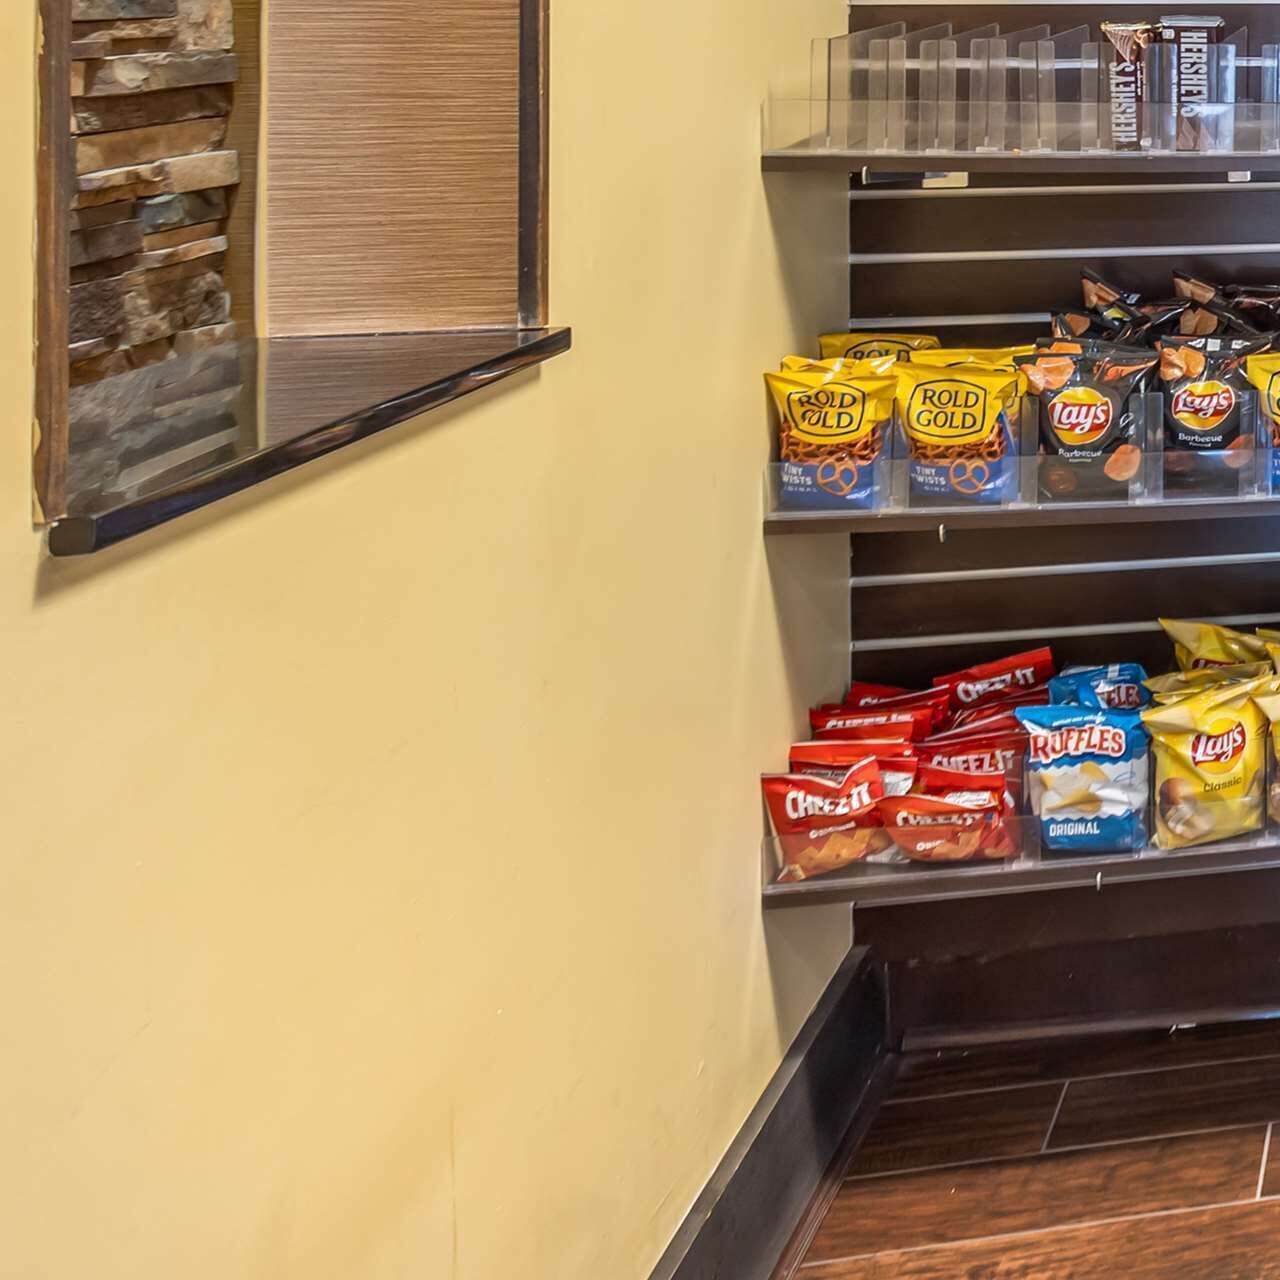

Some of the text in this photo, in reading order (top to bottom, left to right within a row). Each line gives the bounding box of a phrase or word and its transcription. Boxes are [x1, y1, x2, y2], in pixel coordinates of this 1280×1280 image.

[1180, 29, 1208, 118] HERSHEY'S
[1109, 62, 1137, 142] HERSHEY'S
[797, 390, 857, 409] ROLD
[922, 388, 980, 409] ROLD
[1176, 388, 1231, 418] Lay's
[916, 410, 977, 430] GOLD
[1053, 402, 1108, 434] Lay's
[1178, 432, 1223, 443] Barbecue
[1030, 724, 1126, 763] RUFFLES
[1192, 723, 1244, 763] Lay's
[1203, 776, 1243, 793] Classic
[1049, 821, 1101, 837] ORIGINAL
